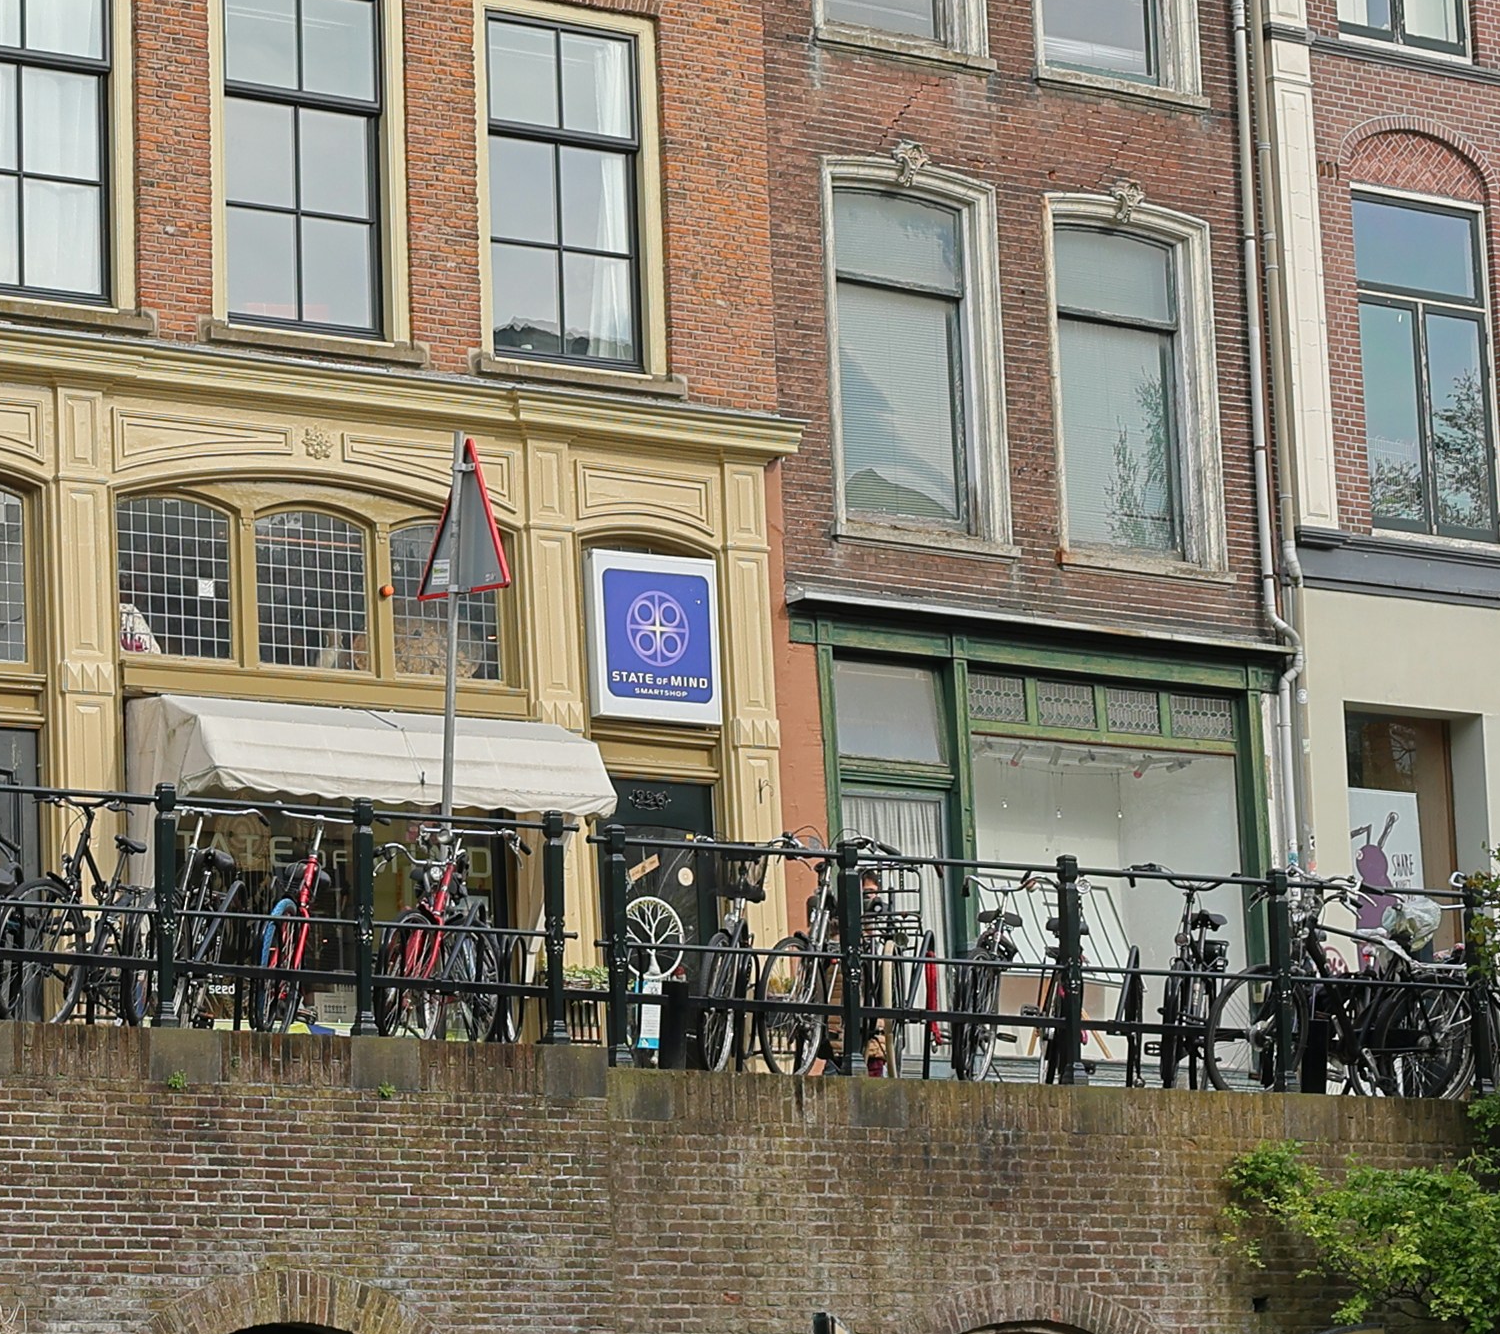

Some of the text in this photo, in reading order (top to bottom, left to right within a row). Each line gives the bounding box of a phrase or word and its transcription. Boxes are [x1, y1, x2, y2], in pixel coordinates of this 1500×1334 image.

[612, 671, 708, 689] STATE OF MIND
[634, 687, 688, 697] SMARTSHOP
[176, 830, 294, 869] TATE
[1391, 854, 1415, 877] SHARE
[209, 982, 236, 995] seed
